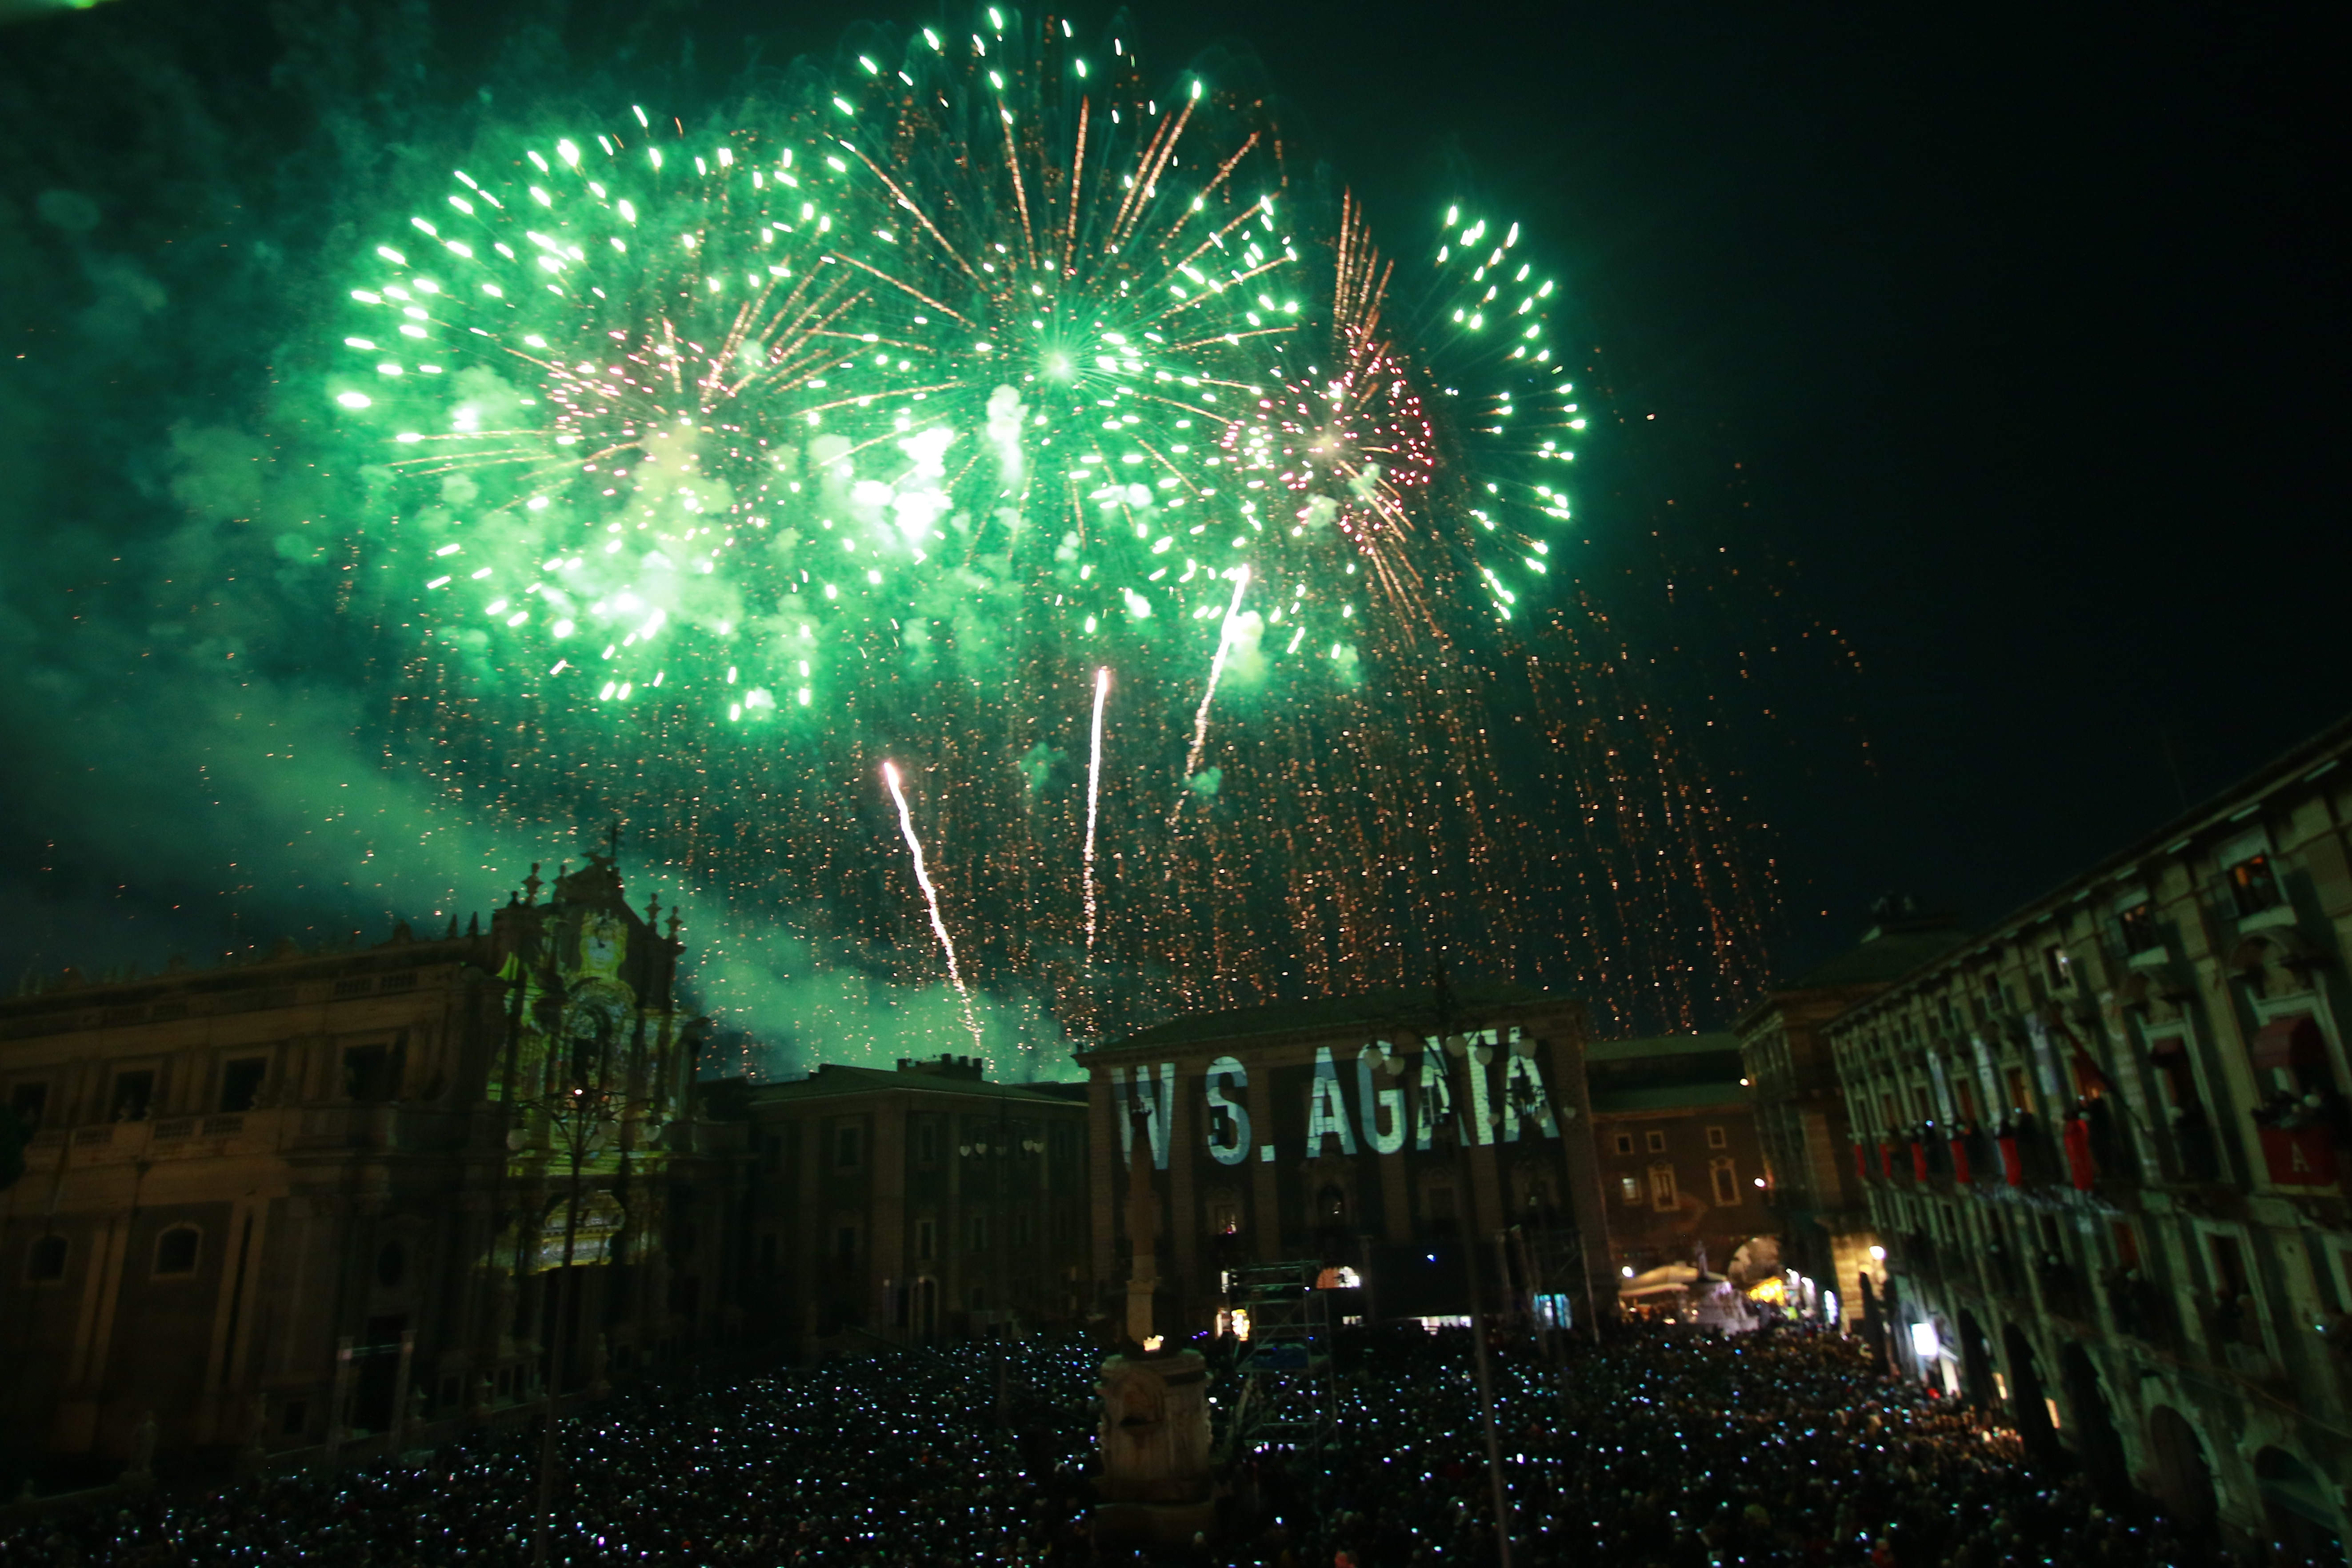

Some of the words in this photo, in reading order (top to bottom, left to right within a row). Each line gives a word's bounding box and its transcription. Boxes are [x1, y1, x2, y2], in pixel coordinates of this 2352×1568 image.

[1111, 1062, 1176, 1172] W
[1205, 1056, 1276, 1165] S.
[1305, 1026, 1560, 1158] AGATA
